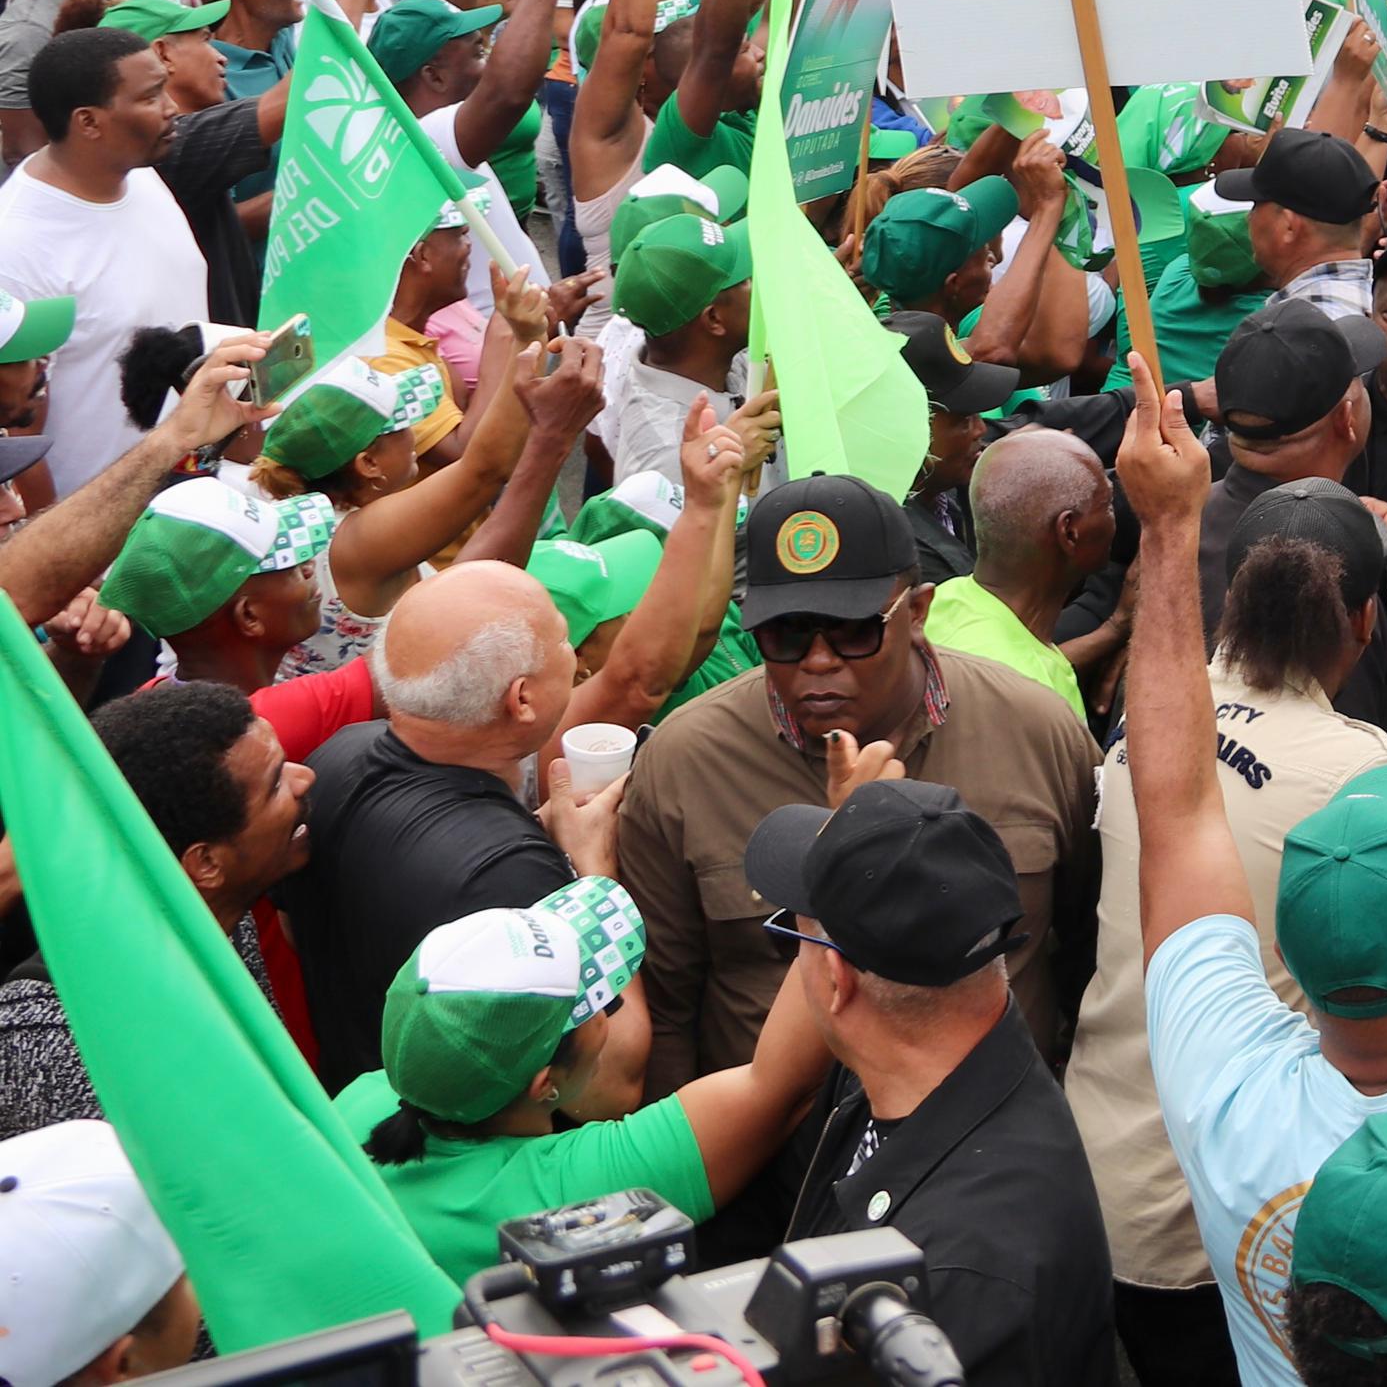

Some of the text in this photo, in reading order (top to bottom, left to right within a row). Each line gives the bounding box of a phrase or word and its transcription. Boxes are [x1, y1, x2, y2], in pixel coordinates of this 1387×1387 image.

[784, 82, 864, 140] Danaides
[1263, 79, 1289, 118] Elvita
[792, 131, 841, 159] DIPUTADA
